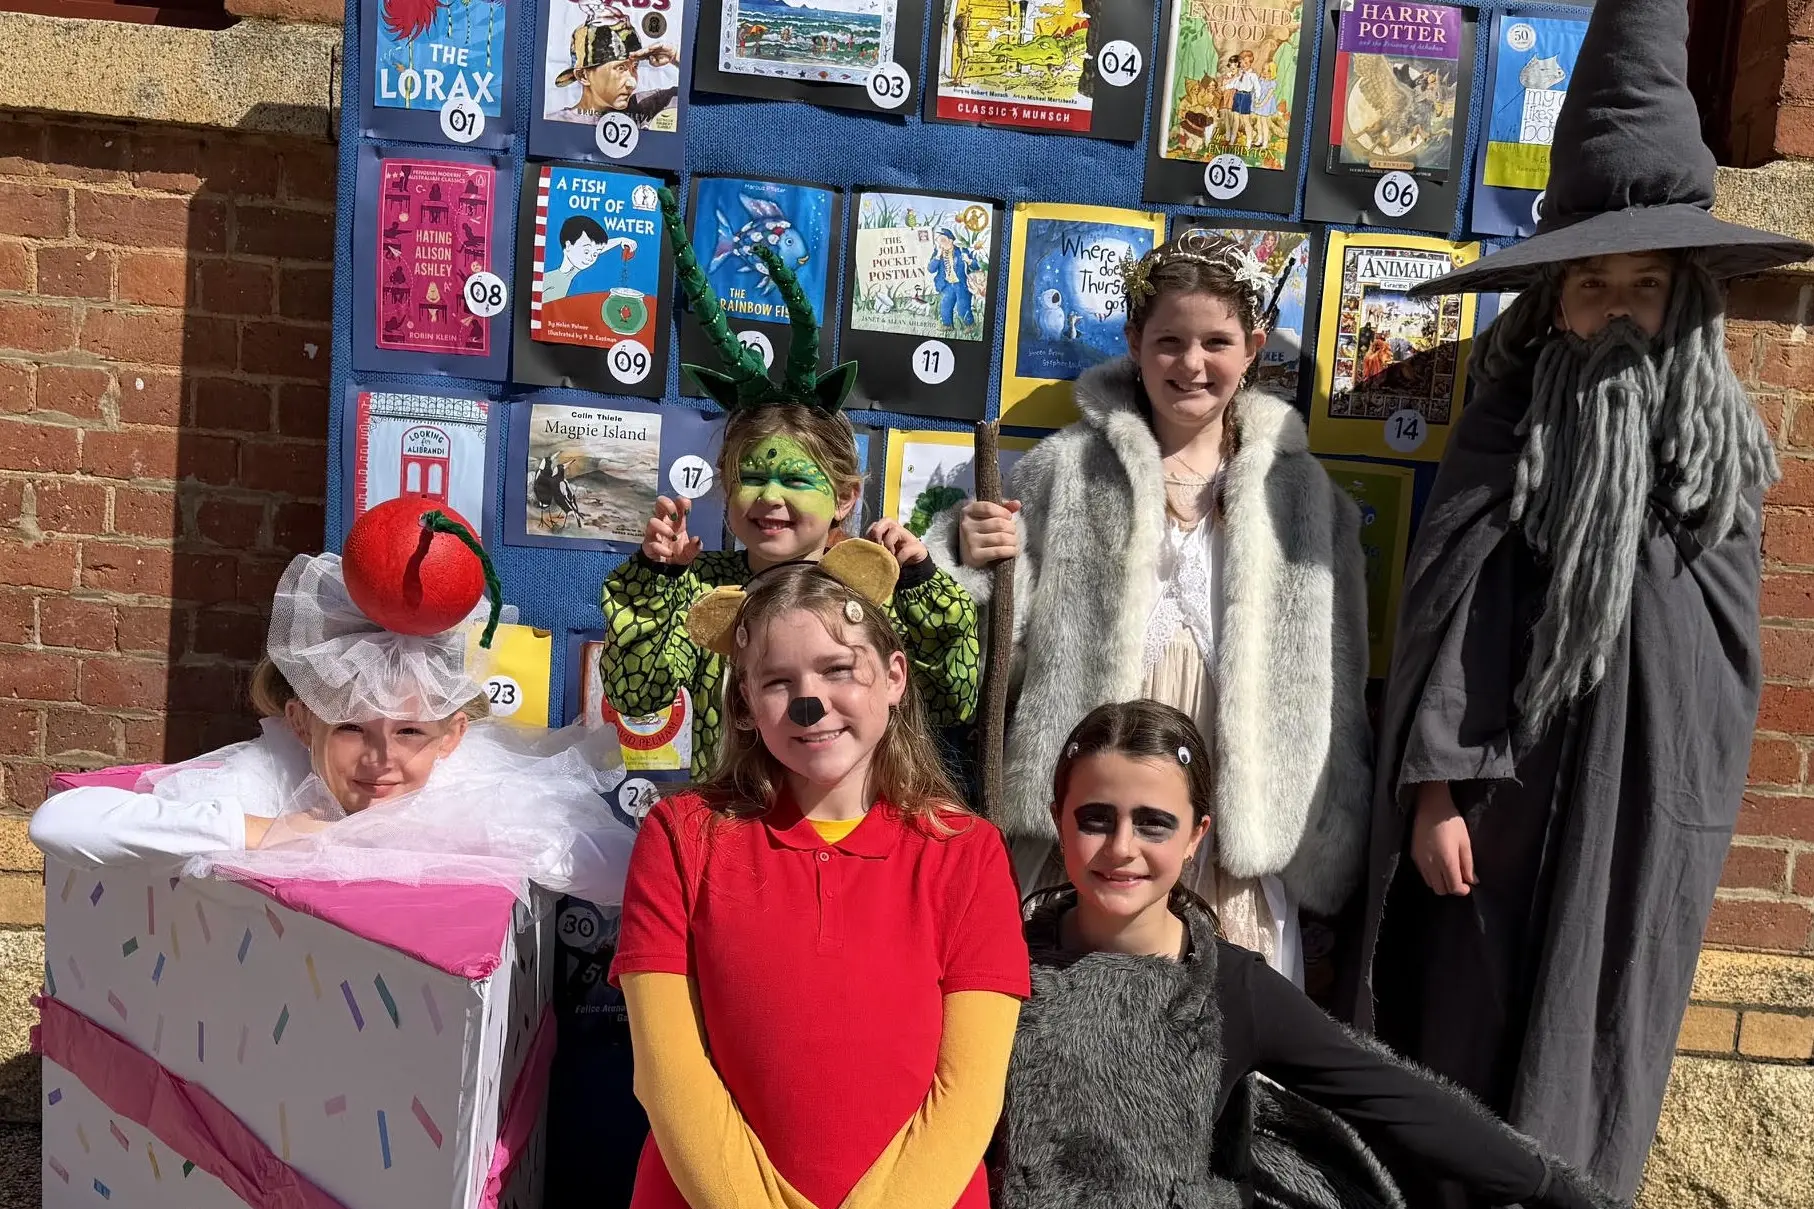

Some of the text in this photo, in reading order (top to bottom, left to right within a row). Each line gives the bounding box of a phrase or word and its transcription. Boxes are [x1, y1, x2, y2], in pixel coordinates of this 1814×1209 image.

[1188, 1, 1293, 25] ENCHANTED
[1361, 4, 1447, 24] HARRY
[1207, 21, 1265, 41] WOOD
[1358, 22, 1447, 43] POTTER
[1514, 30, 1528, 41] 50
[429, 43, 469, 67] THE
[1102, 52, 1136, 77] 04
[380, 68, 494, 103] LORAX
[873, 74, 904, 98] 03
[1526, 90, 1556, 107] my
[449, 109, 476, 136] 01
[957, 103, 1070, 122] CLASSIC MUNSCH
[1524, 105, 1554, 122] likes
[603, 121, 632, 148] 02
[556, 176, 607, 194] A FISH
[1209, 164, 1240, 189] 05
[1382, 181, 1413, 207] 06
[569, 195, 625, 214] OUT OF
[604, 216, 655, 235] WATER
[416, 229, 452, 245] HATING
[883, 236, 902, 245] THE
[1062, 232, 1116, 262] Where
[415, 246, 452, 261] ALISON
[879, 245, 906, 256] JOLLY
[414, 263, 452, 277] ASHLEY
[872, 255, 917, 268] POCKET
[1360, 257, 1444, 279] ANIMALIA
[869, 267, 926, 282] POSTMAN
[470, 281, 502, 306] 08
[730, 288, 746, 299] THE
[720, 298, 773, 316] RAINBOW
[1105, 296, 1127, 318] go?
[409, 331, 457, 341] ROBIN KLEIN
[614, 351, 646, 376] 09
[923, 350, 940, 373] 11
[571, 411, 623, 422] Colin Thiele
[409, 430, 444, 443] LOOKING
[544, 420, 647, 440] Magpie Island
[1396, 416, 1418, 440] 14
[407, 446, 444, 455] ALIBRANDI
[682, 466, 703, 488] 17
[489, 682, 515, 704] 23
[639, 721, 678, 747] PELHAM
[563, 914, 594, 938] 30
